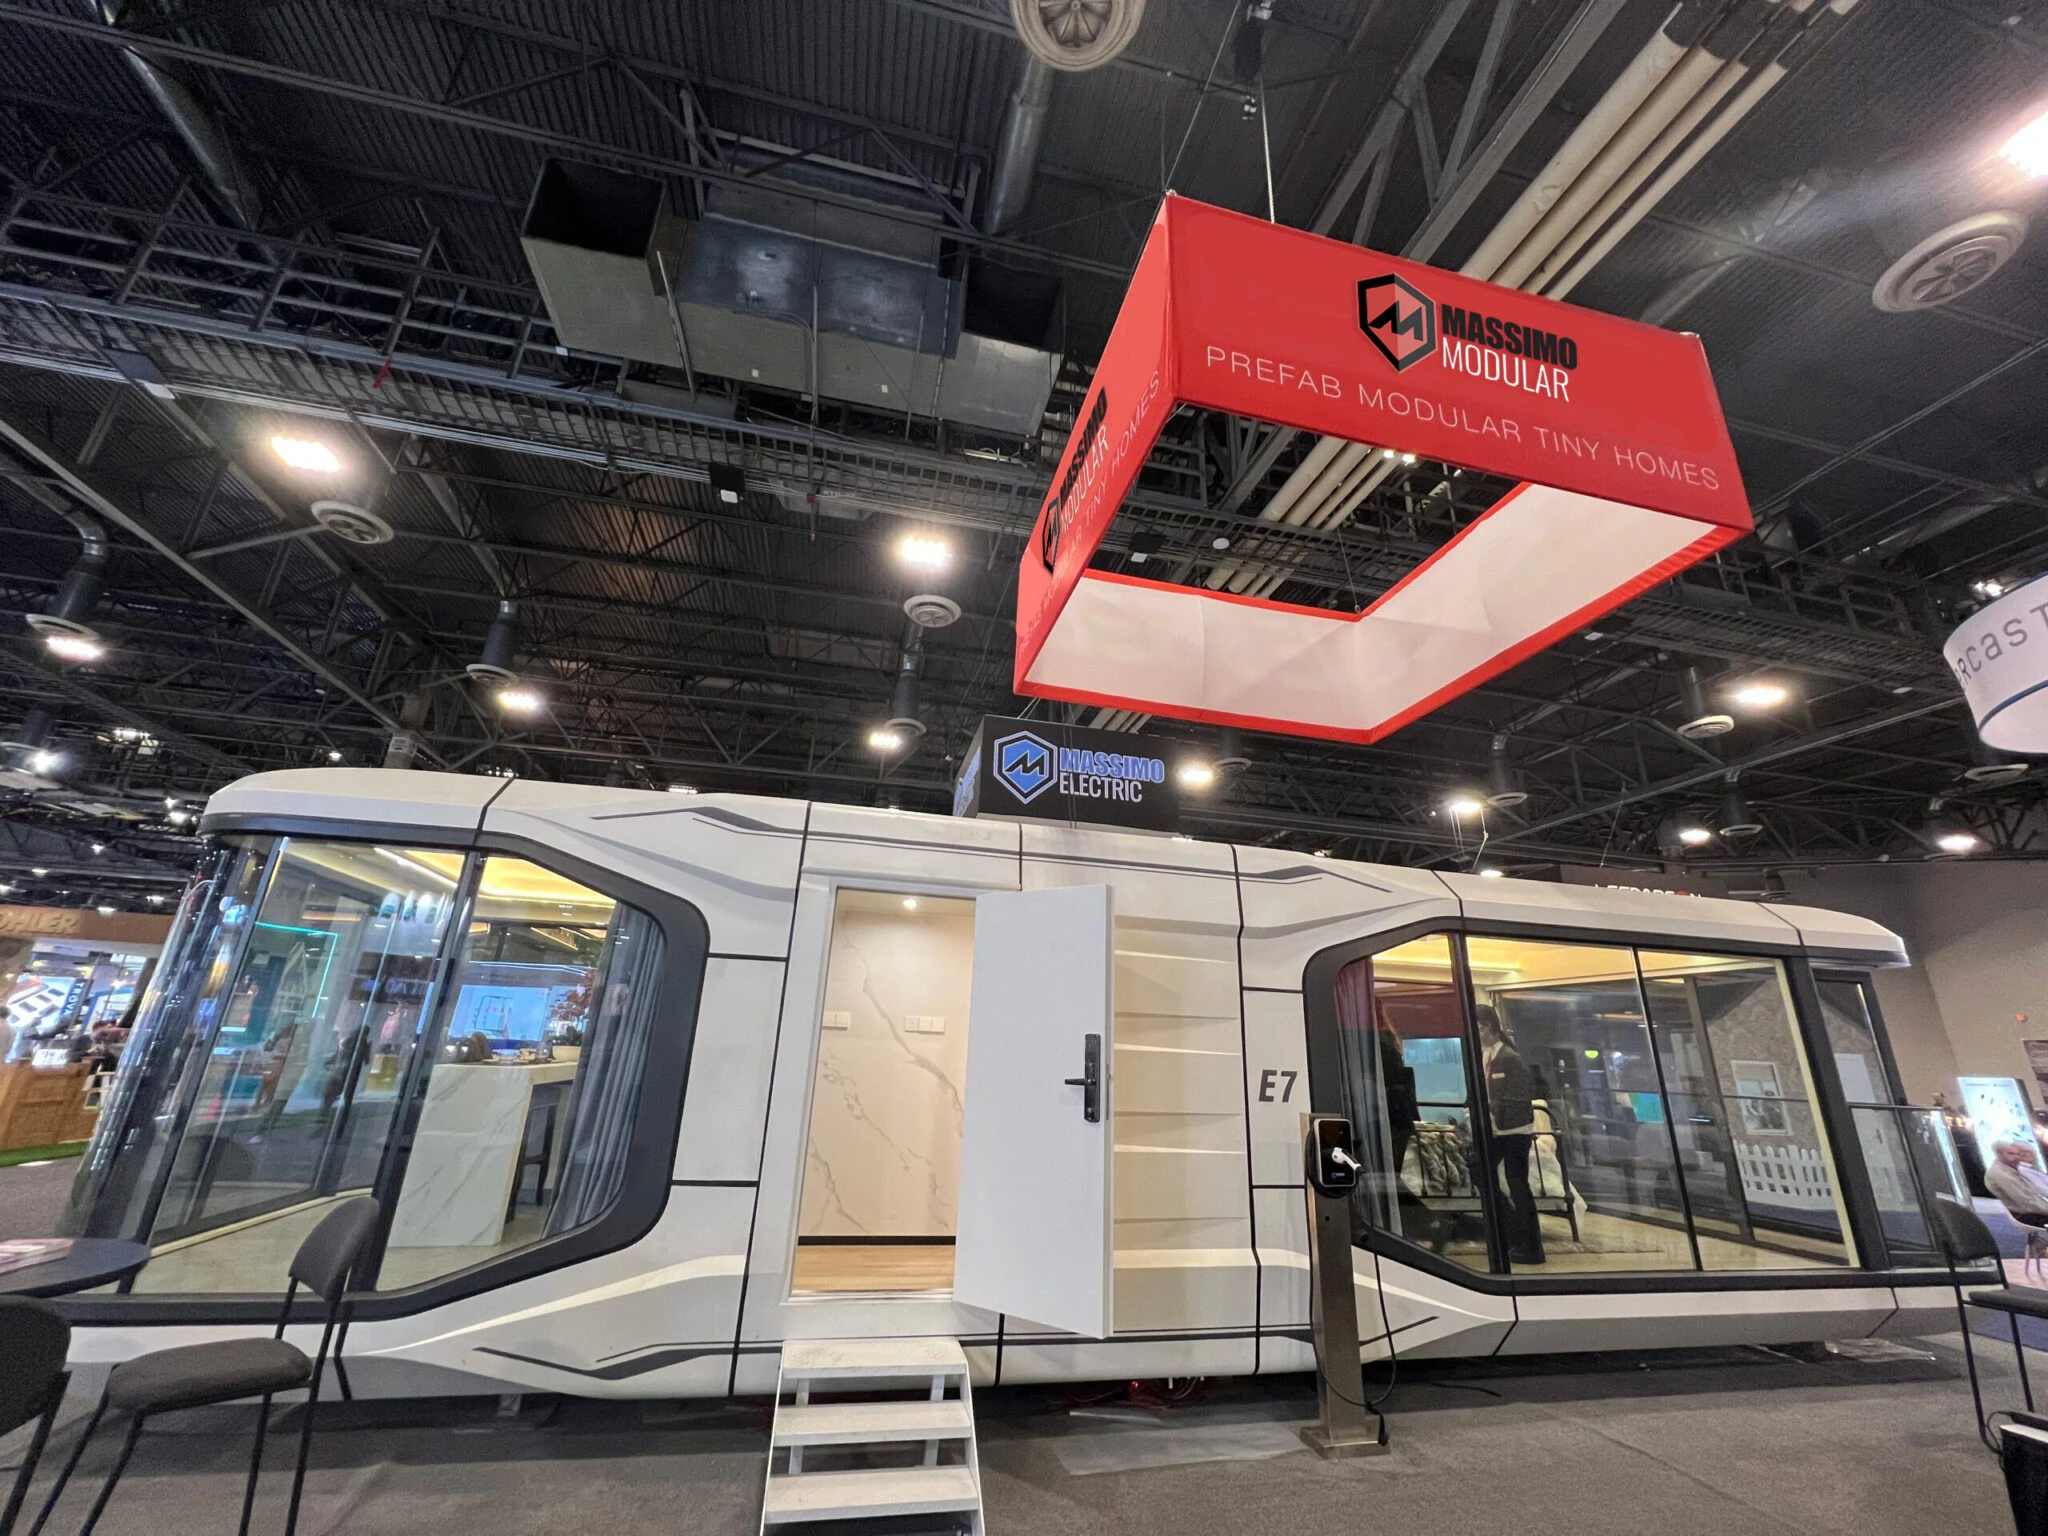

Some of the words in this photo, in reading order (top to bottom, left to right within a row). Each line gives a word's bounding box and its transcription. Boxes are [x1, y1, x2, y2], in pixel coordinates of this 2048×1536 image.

[1441, 303, 1578, 370] MASSIMO
[1442, 337, 1570, 402] MODULAR
[1059, 386, 1108, 510] MASSIMO
[1085, 471, 1108, 527] TINY
[1111, 370, 1159, 477] HOMES
[1206, 345, 1342, 399] PREFAB
[1358, 383, 1521, 443] MODULAR
[1533, 426, 1600, 461] TINY
[1614, 446, 1719, 490] HOMES
[1061, 424, 1109, 537] MODULAR
[1059, 747, 1165, 784] MASSIMO
[1059, 772, 1143, 803] ELECTRIC
[1258, 1069, 1298, 1103] E7
